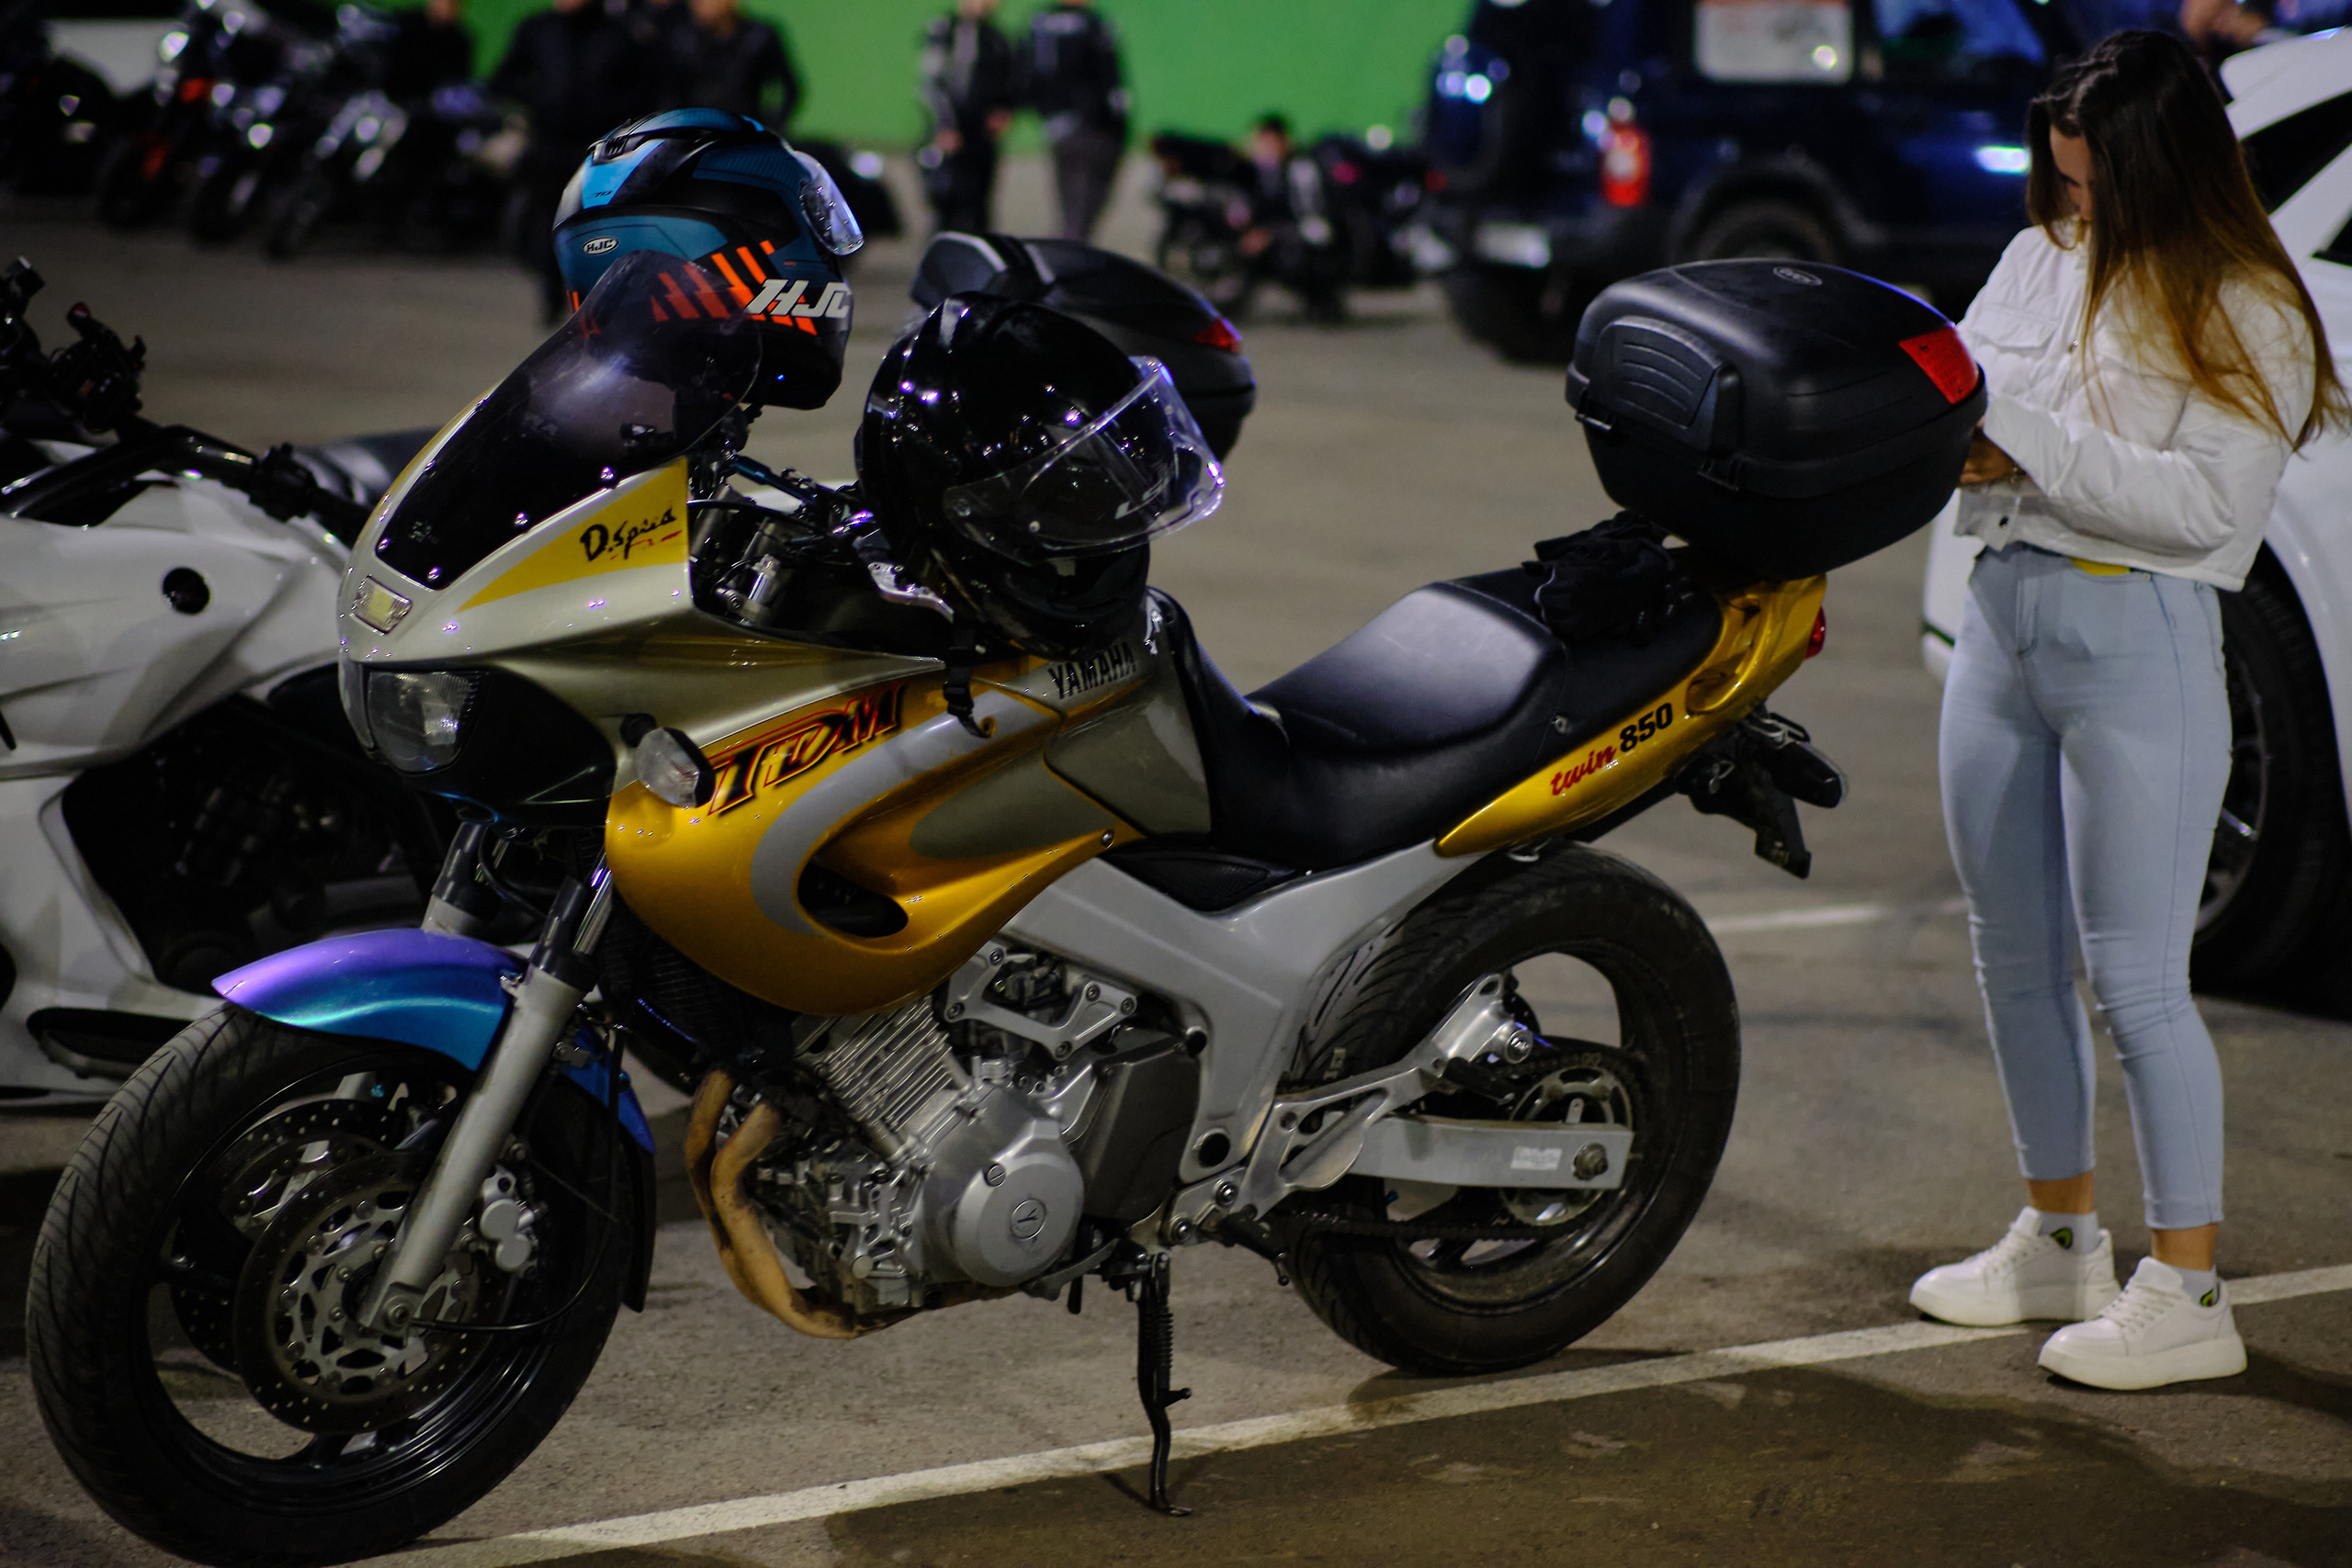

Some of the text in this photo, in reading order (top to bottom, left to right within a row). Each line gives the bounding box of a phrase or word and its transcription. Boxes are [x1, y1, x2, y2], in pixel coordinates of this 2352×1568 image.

[585, 237, 615, 253] HJC
[745, 278, 853, 319] HJC
[1047, 641, 1136, 700] YAMAHA
[707, 682, 905, 817] TDM
[1550, 703, 1673, 796] twin 850
